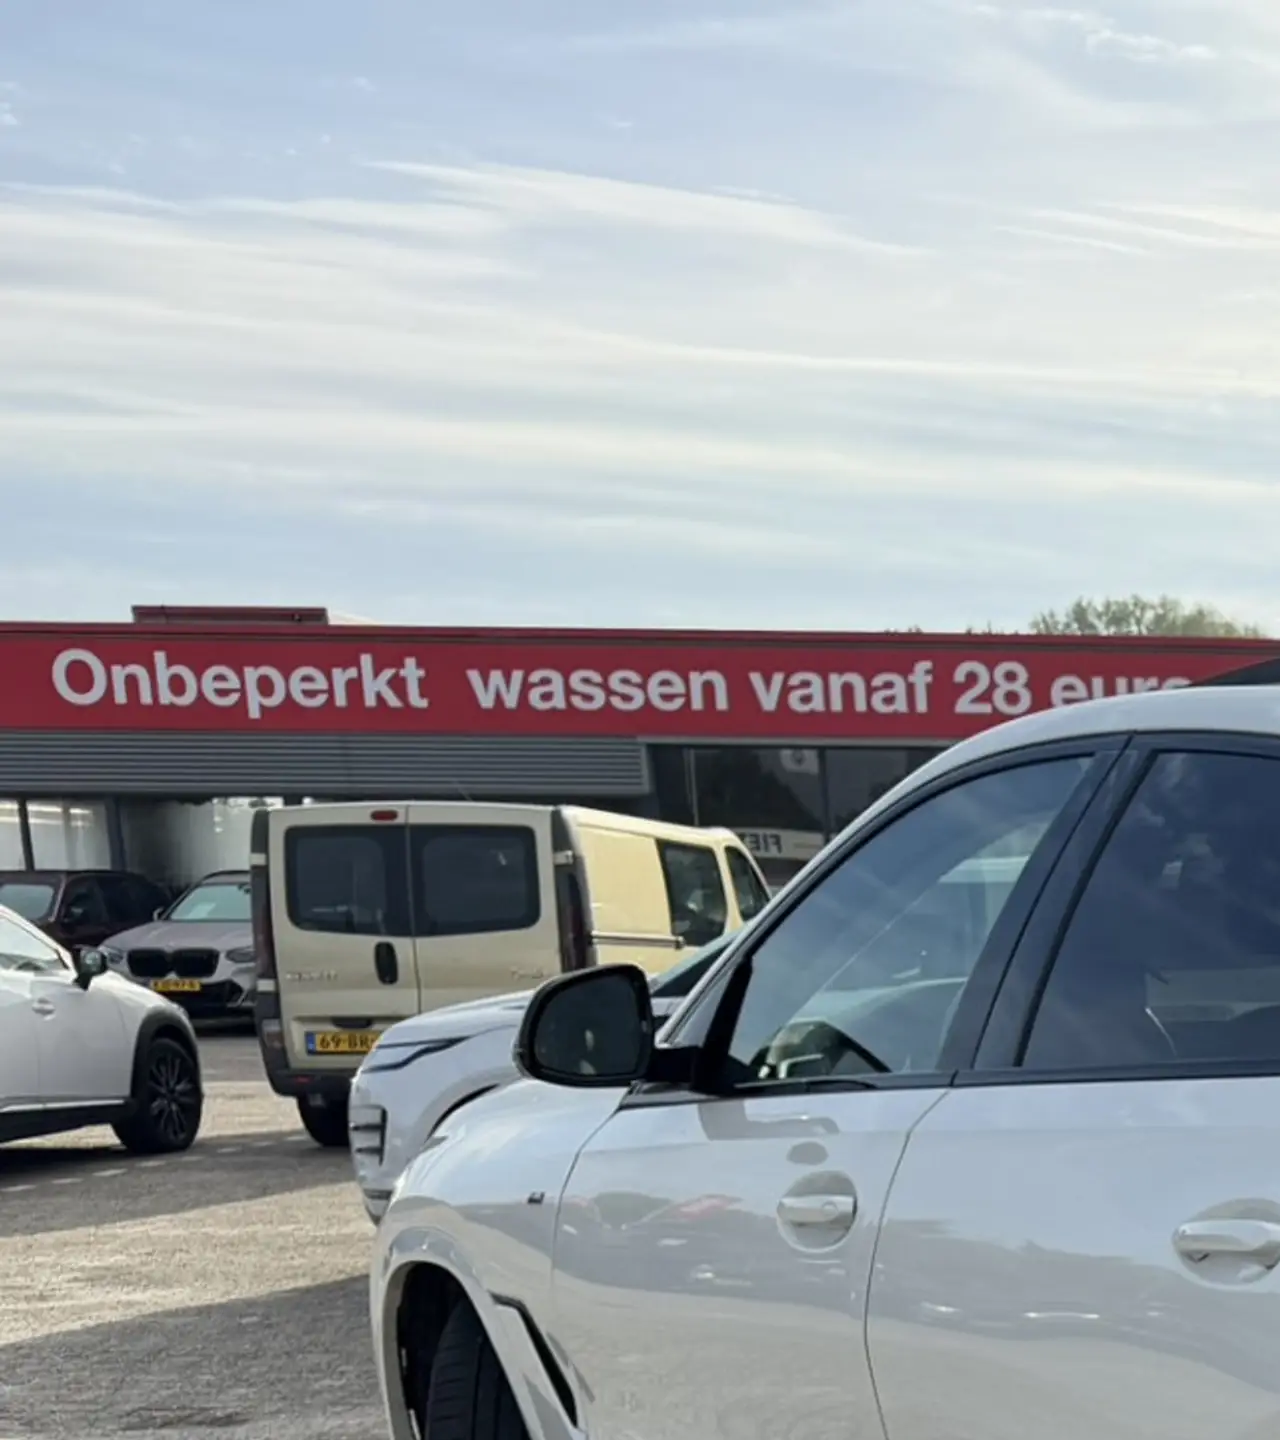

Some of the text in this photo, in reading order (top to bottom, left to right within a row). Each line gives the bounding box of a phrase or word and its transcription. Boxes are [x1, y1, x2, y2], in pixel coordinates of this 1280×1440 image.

[52, 648, 429, 719] Onbeperkt
[466, 669, 729, 712] wassen
[749, 660, 933, 714] vanaf
[954, 661, 1032, 715] 28
